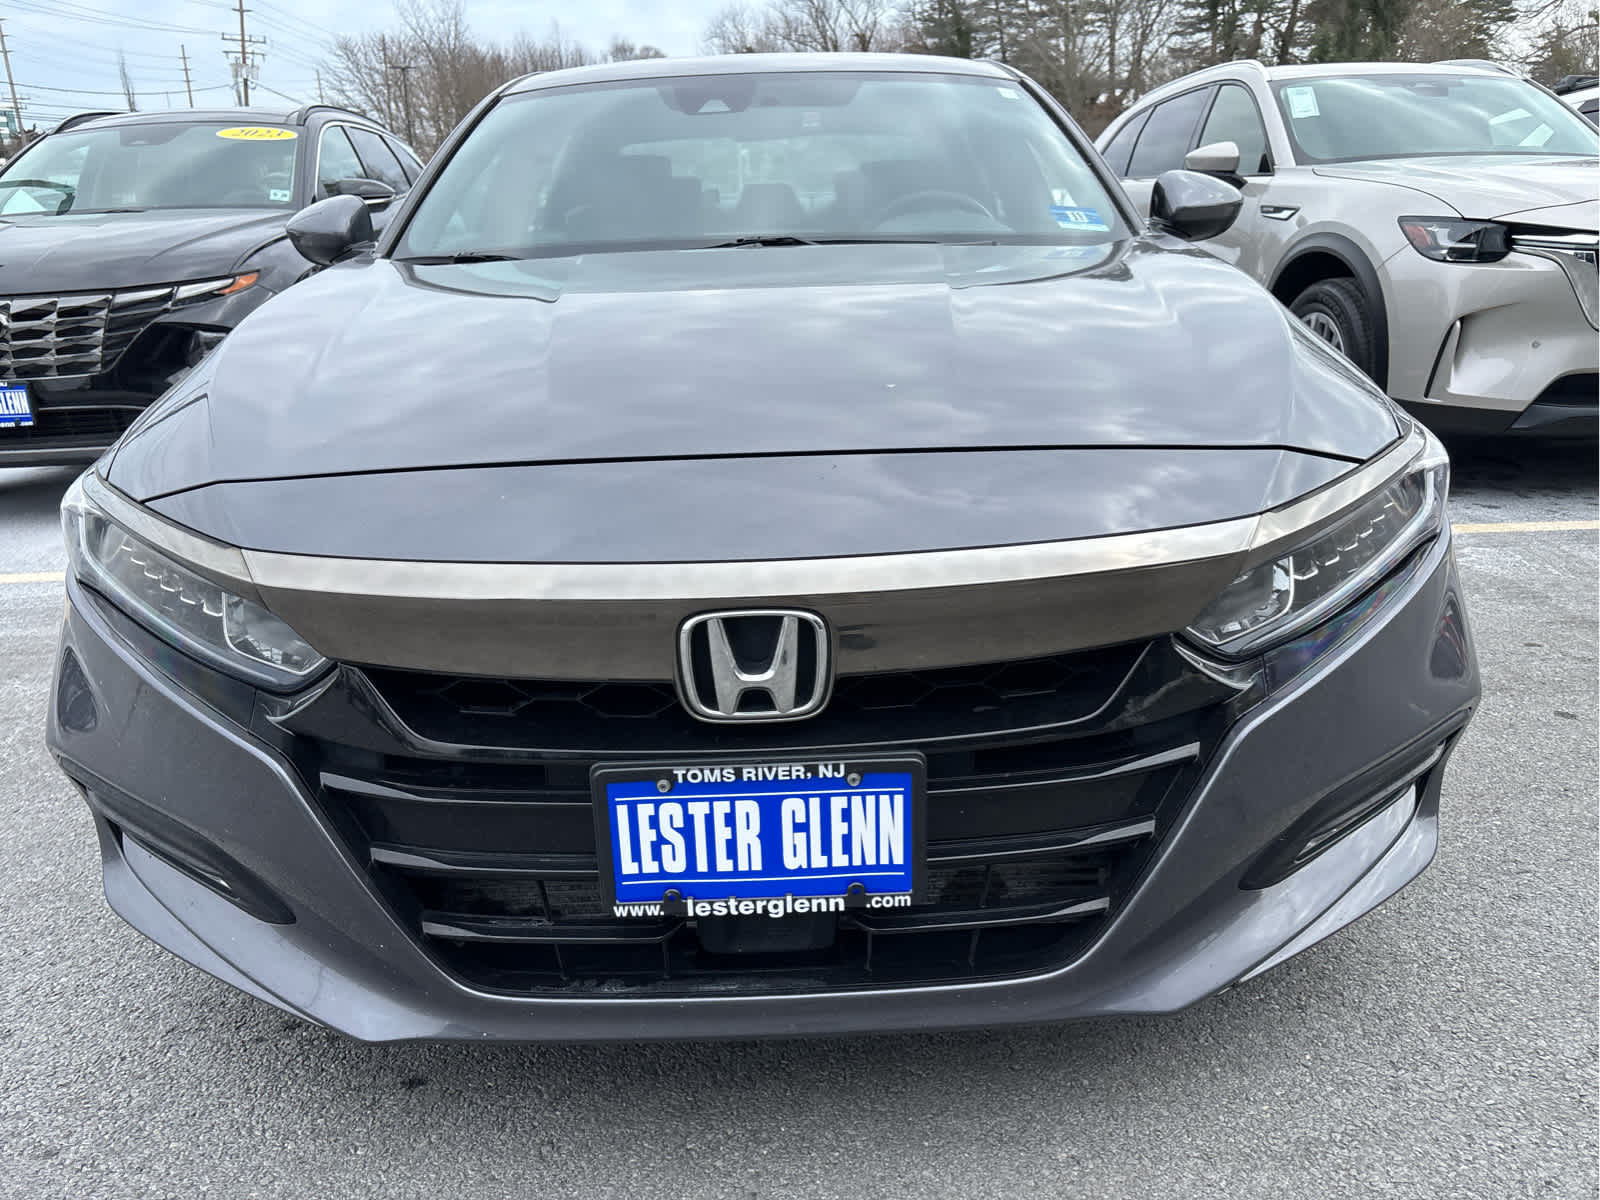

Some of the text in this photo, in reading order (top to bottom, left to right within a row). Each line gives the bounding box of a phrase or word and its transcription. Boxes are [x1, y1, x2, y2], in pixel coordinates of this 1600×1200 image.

[0, 391, 30, 414] LENN
[673, 763, 846, 784] TOMS RIVER, NJ
[616, 795, 905, 875] LESTER GLENN
[613, 895, 911, 918] www. lesterglenn .com
